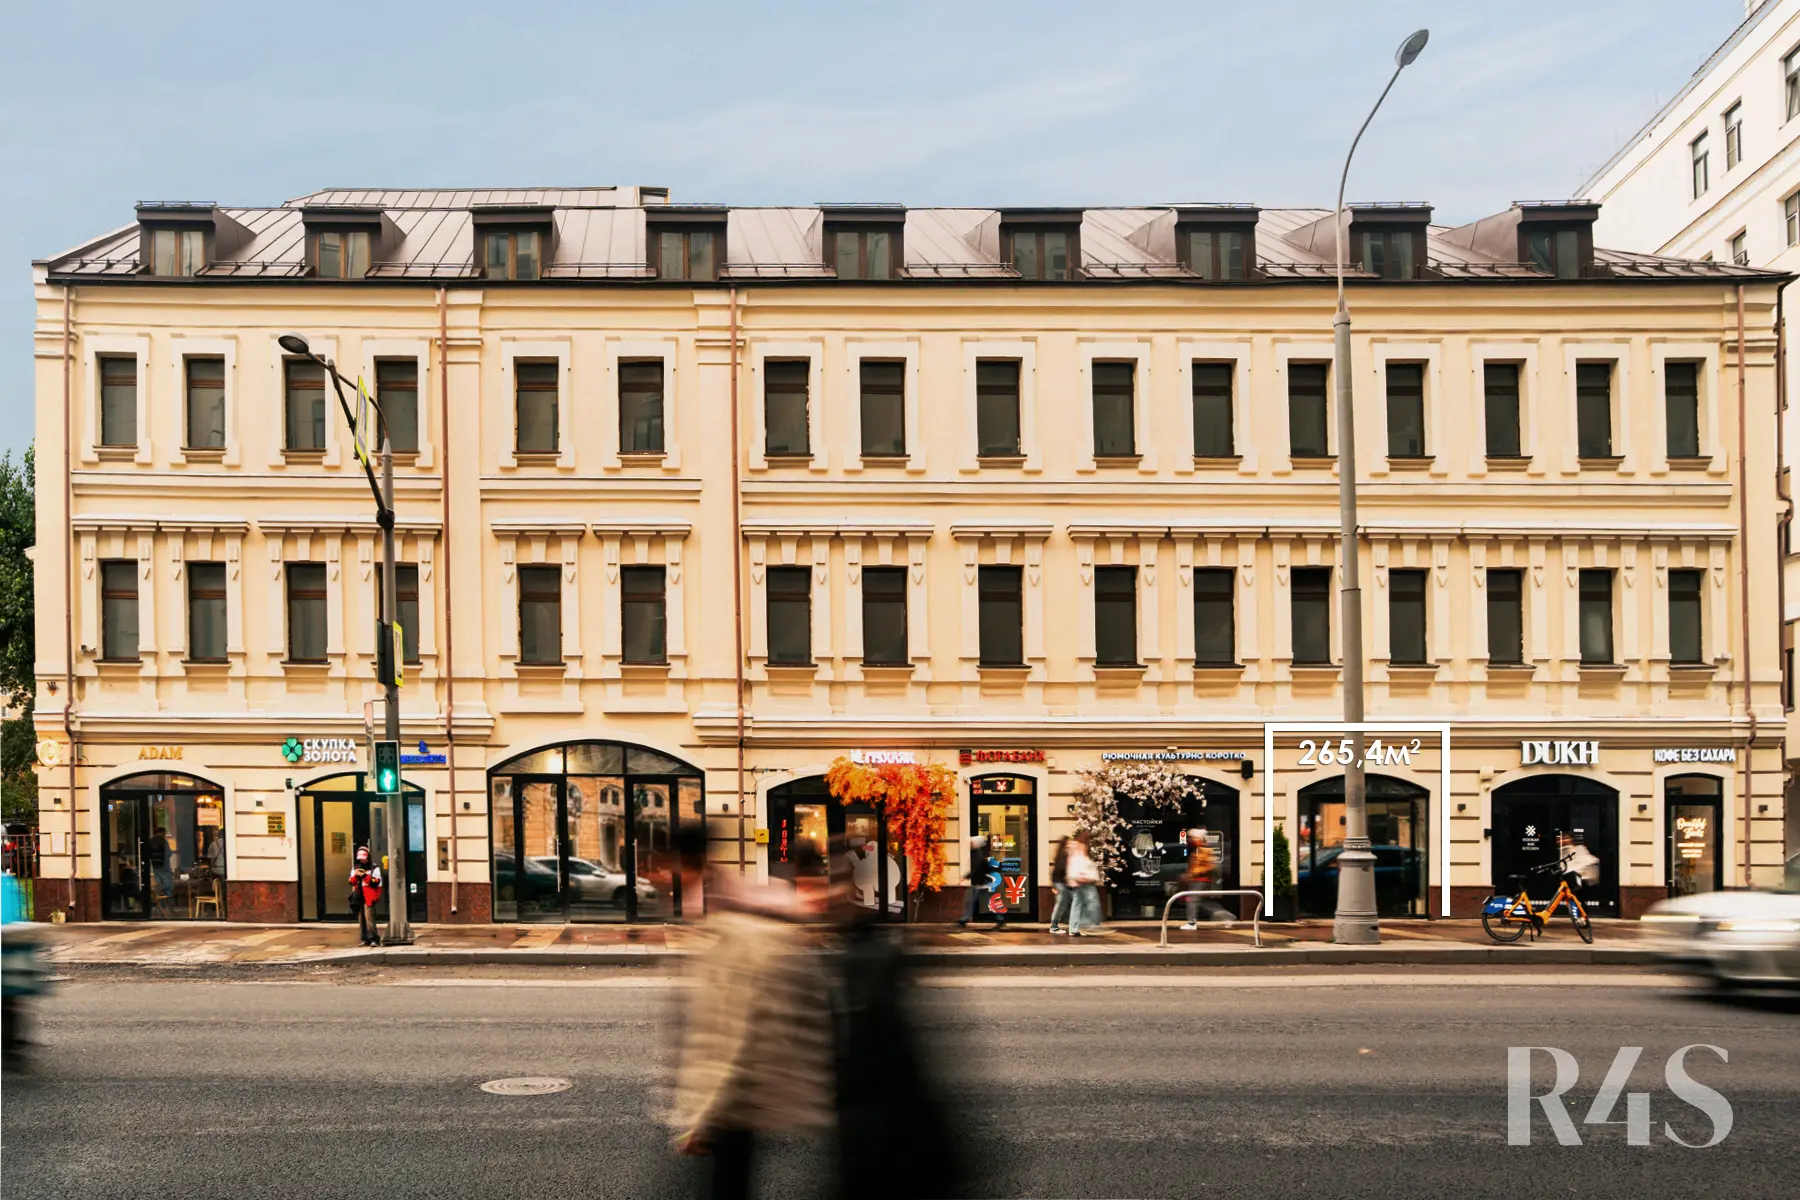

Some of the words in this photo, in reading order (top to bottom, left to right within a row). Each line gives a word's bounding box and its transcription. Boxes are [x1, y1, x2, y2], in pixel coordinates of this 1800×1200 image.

[303, 739, 356, 751] СКУПКА
[138, 746, 184, 760] ADAM
[303, 751, 356, 763] ЗОЛОТА
[1520, 741, 1600, 765] DUKH
[1653, 749, 1680, 762] КОФЕ
[1681, 749, 1699, 762] БЕЗ
[1700, 749, 1736, 762] САХАРА
